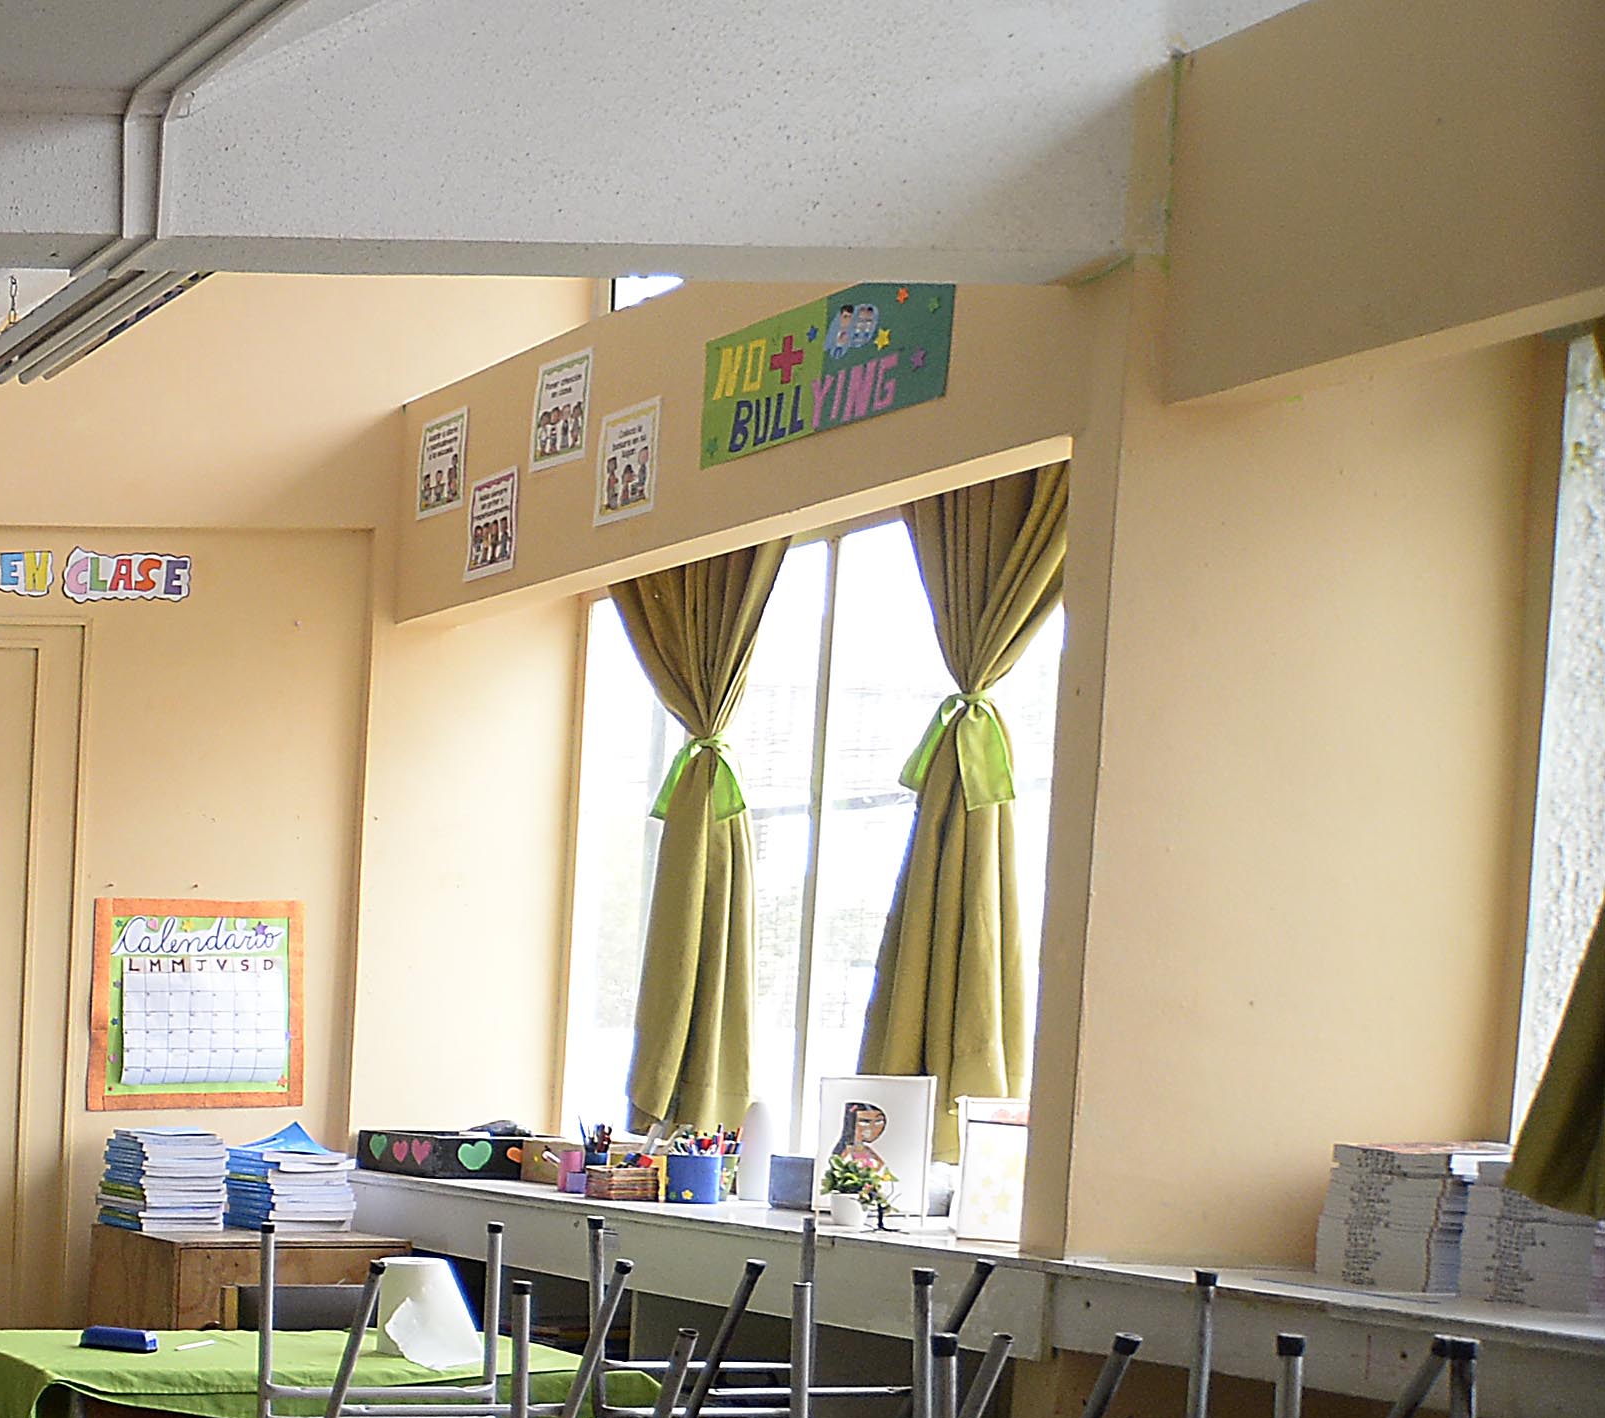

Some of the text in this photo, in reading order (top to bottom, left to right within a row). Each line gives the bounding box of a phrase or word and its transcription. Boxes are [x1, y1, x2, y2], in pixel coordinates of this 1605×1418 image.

[713, 339, 768, 401] NO
[728, 353, 899, 453] BULLYING
[0, 551, 50, 591] EN
[66, 556, 188, 595] CLASE
[111, 916, 283, 954] Calendario
[127, 958, 275, 973] L M M J V S D
